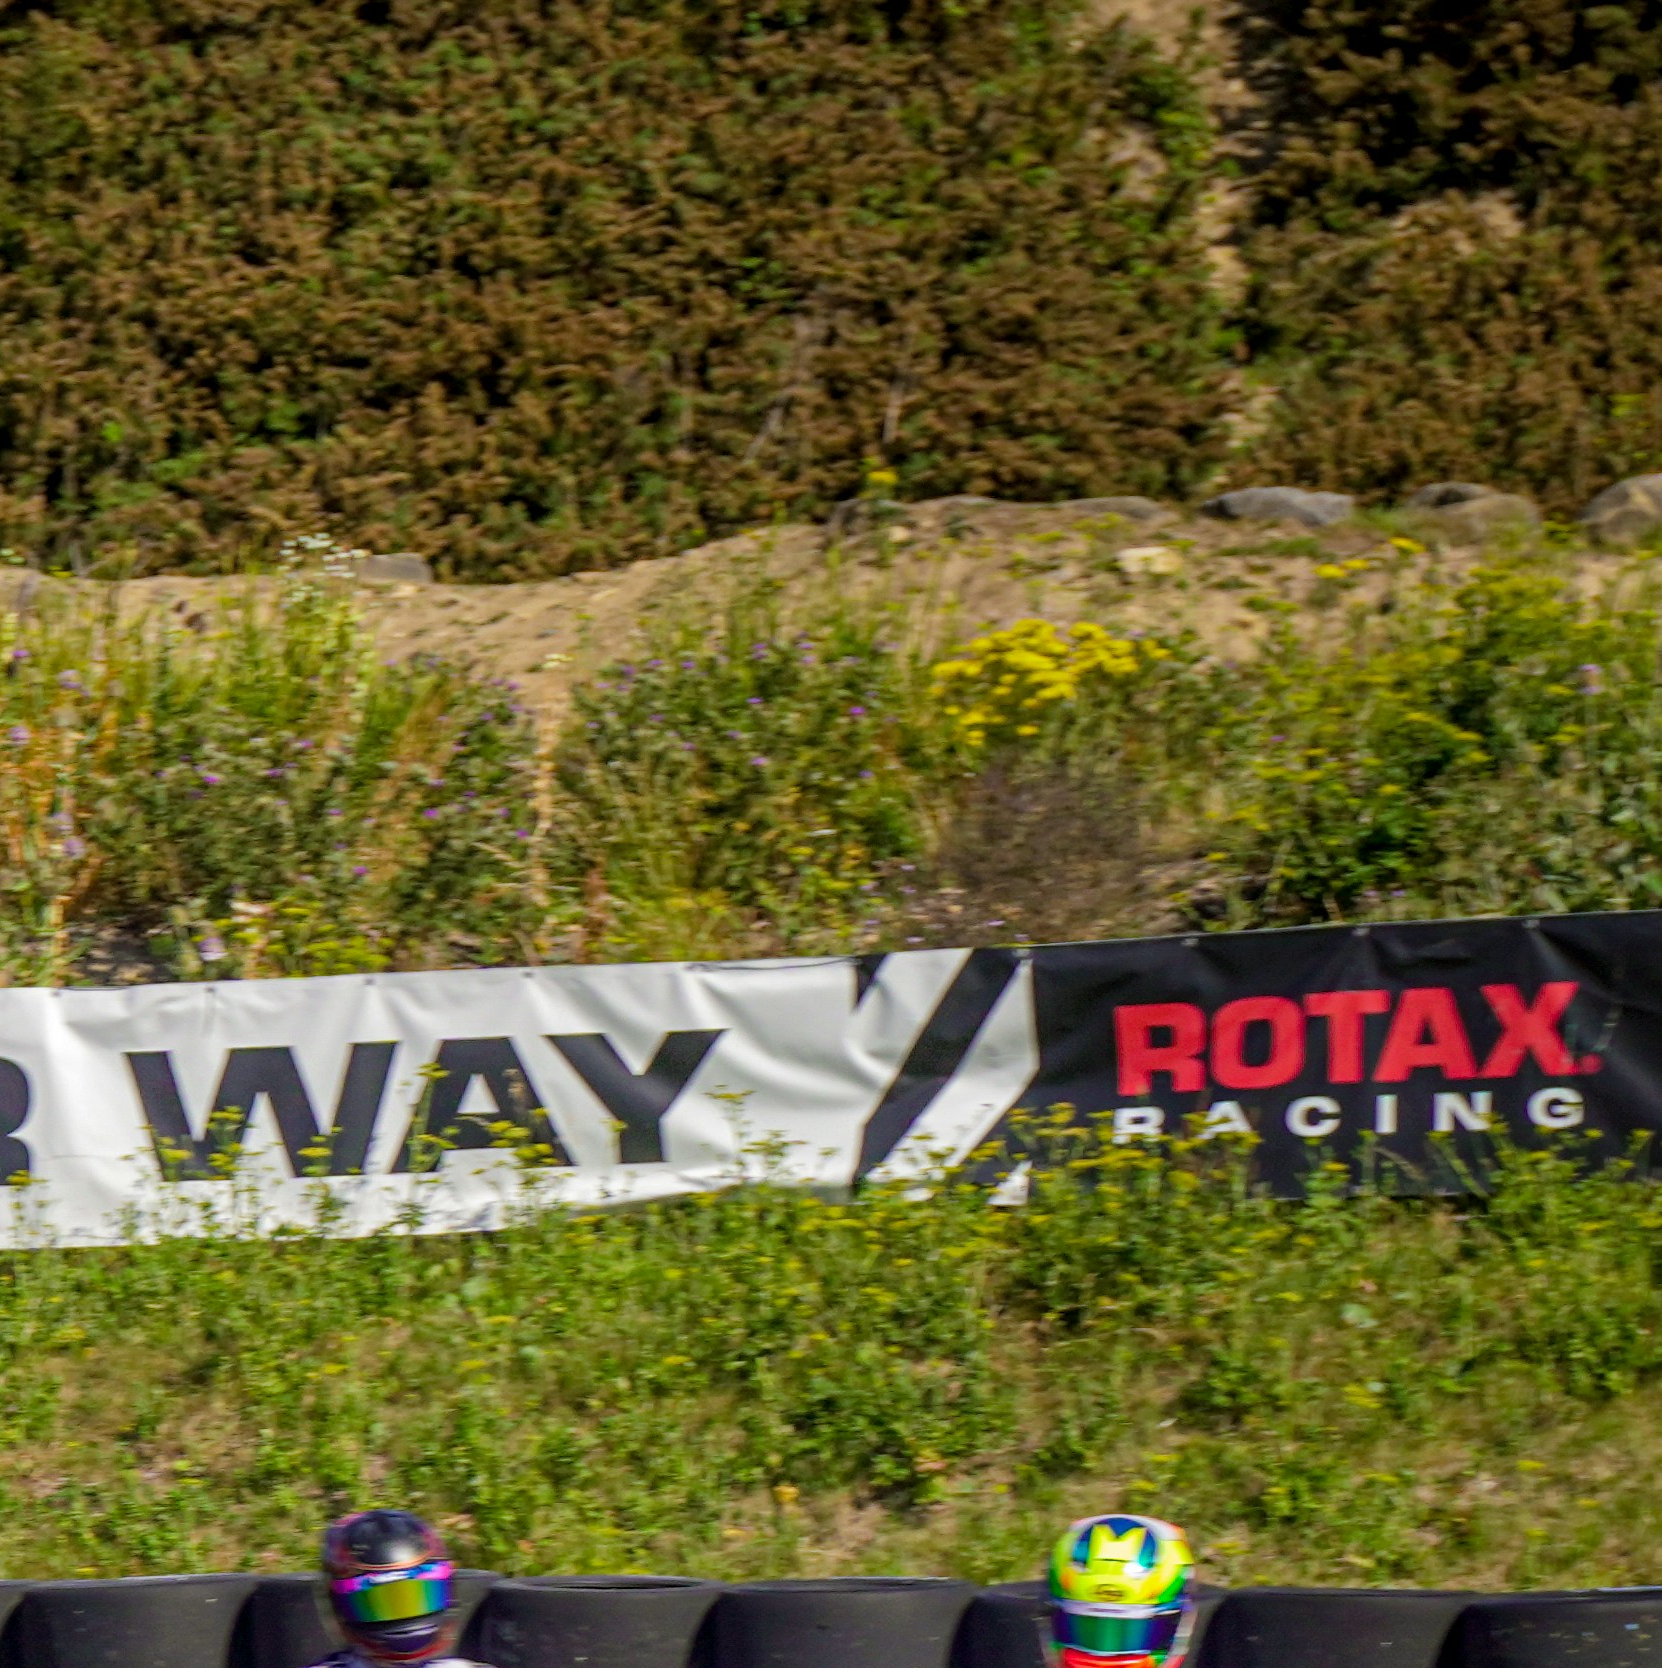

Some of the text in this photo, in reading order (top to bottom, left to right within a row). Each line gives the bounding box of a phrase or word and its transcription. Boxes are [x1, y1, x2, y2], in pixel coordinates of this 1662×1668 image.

[1114, 982, 1579, 1097] ROTAX
[125, 1031, 733, 1182] WAY
[1113, 1088, 1585, 1146] RACING
